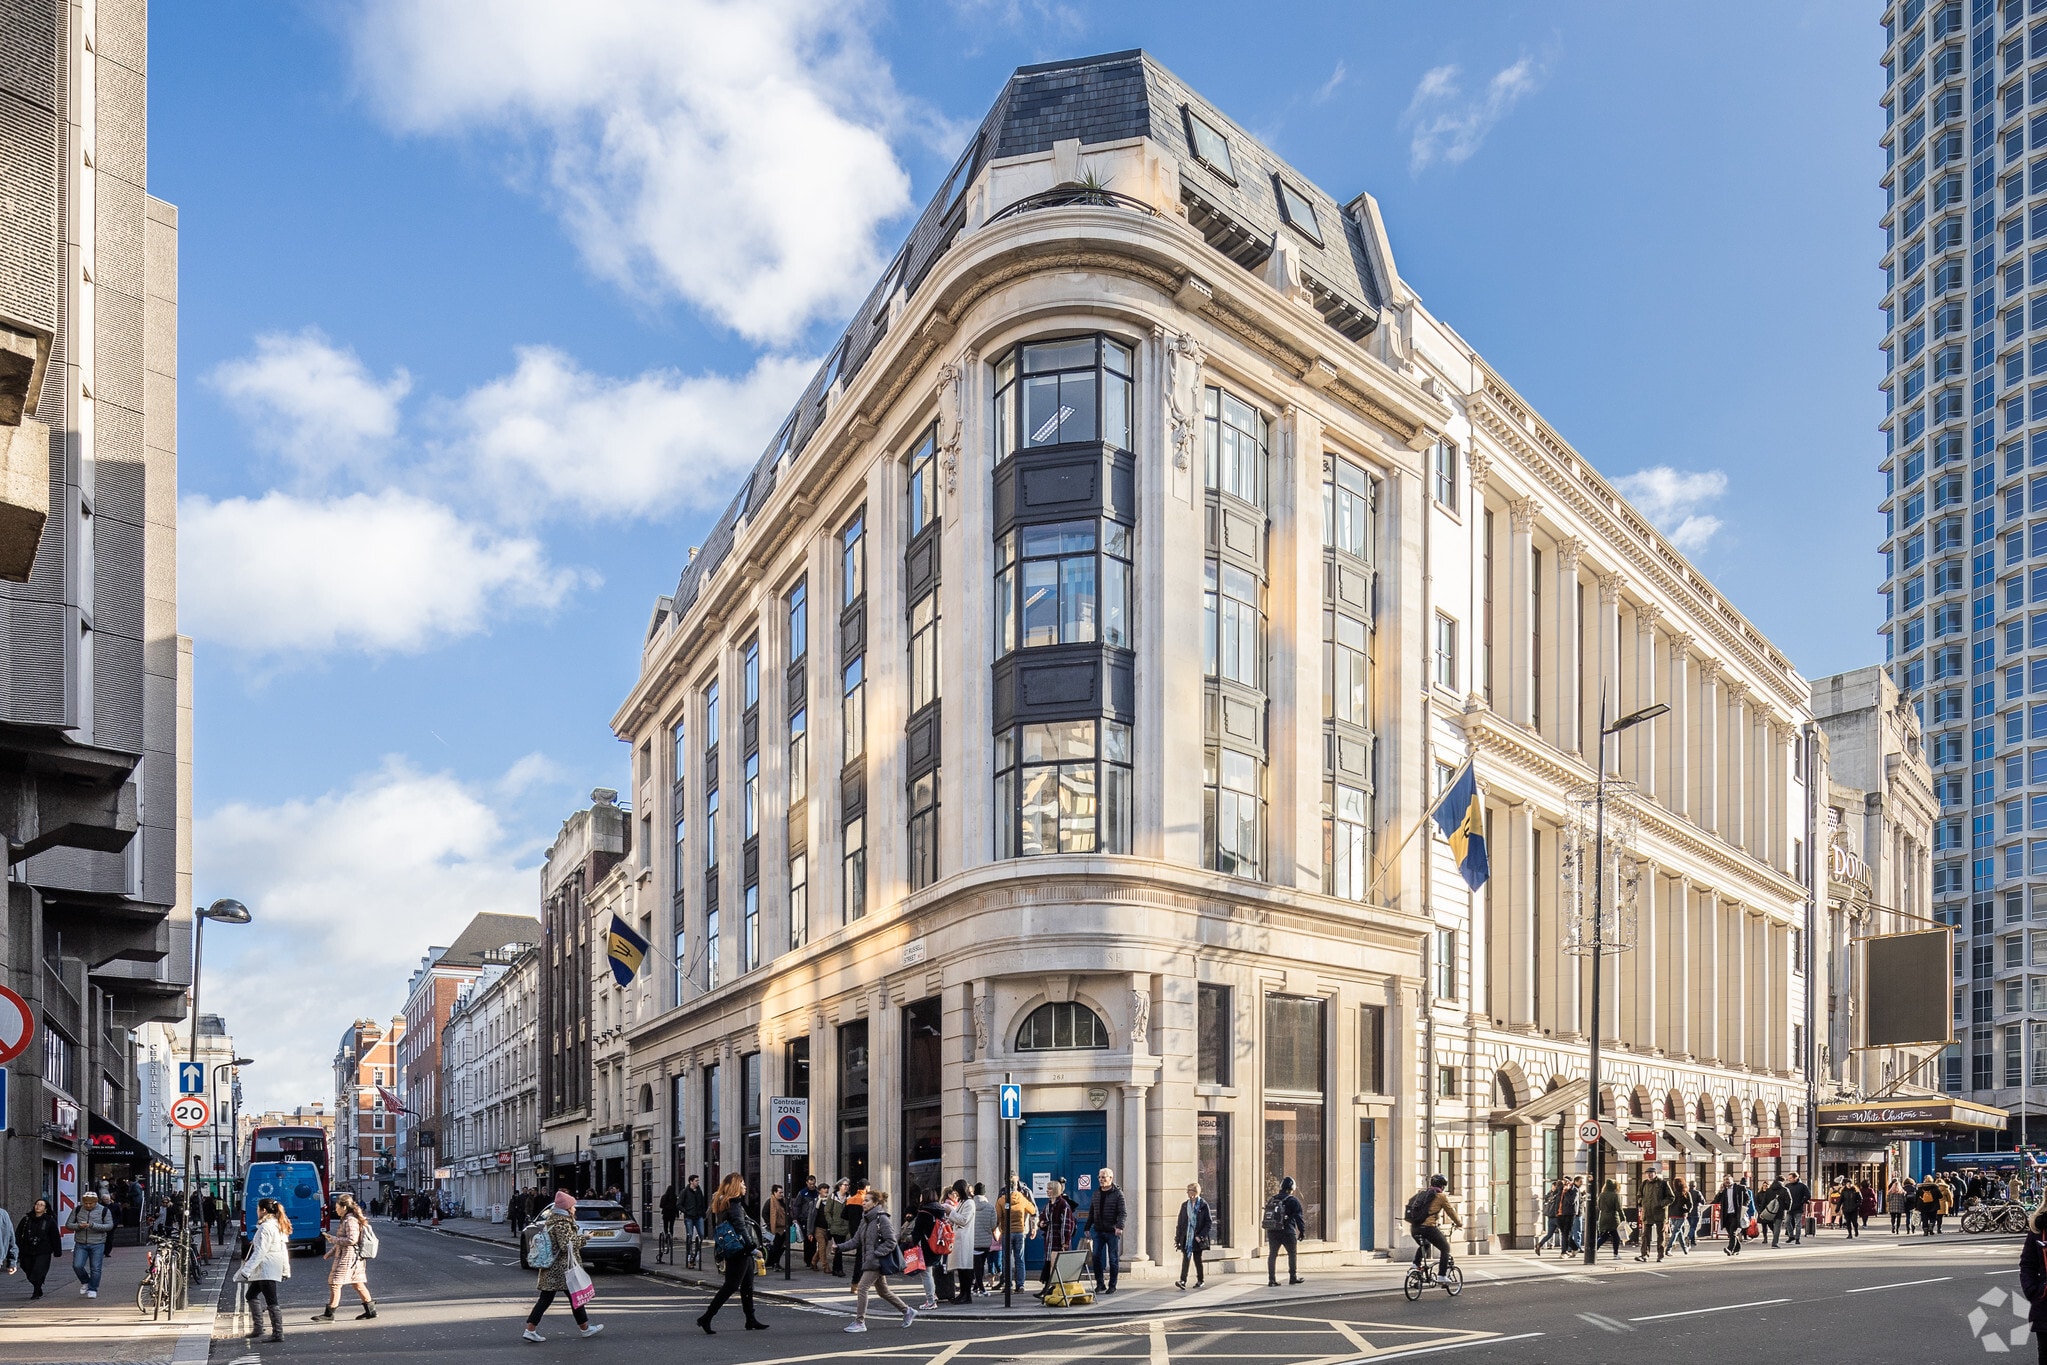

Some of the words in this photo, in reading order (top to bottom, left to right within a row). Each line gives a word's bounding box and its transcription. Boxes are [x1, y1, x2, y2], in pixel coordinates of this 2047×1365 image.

[150, 1101, 158, 1132] HOTEL
[176, 1106, 203, 1120] 20
[1851, 1110, 1880, 1123] White
[1582, 1126, 1598, 1137] 20
[284, 1154, 297, 1162] 176
[500, 1153, 511, 1162] illy
